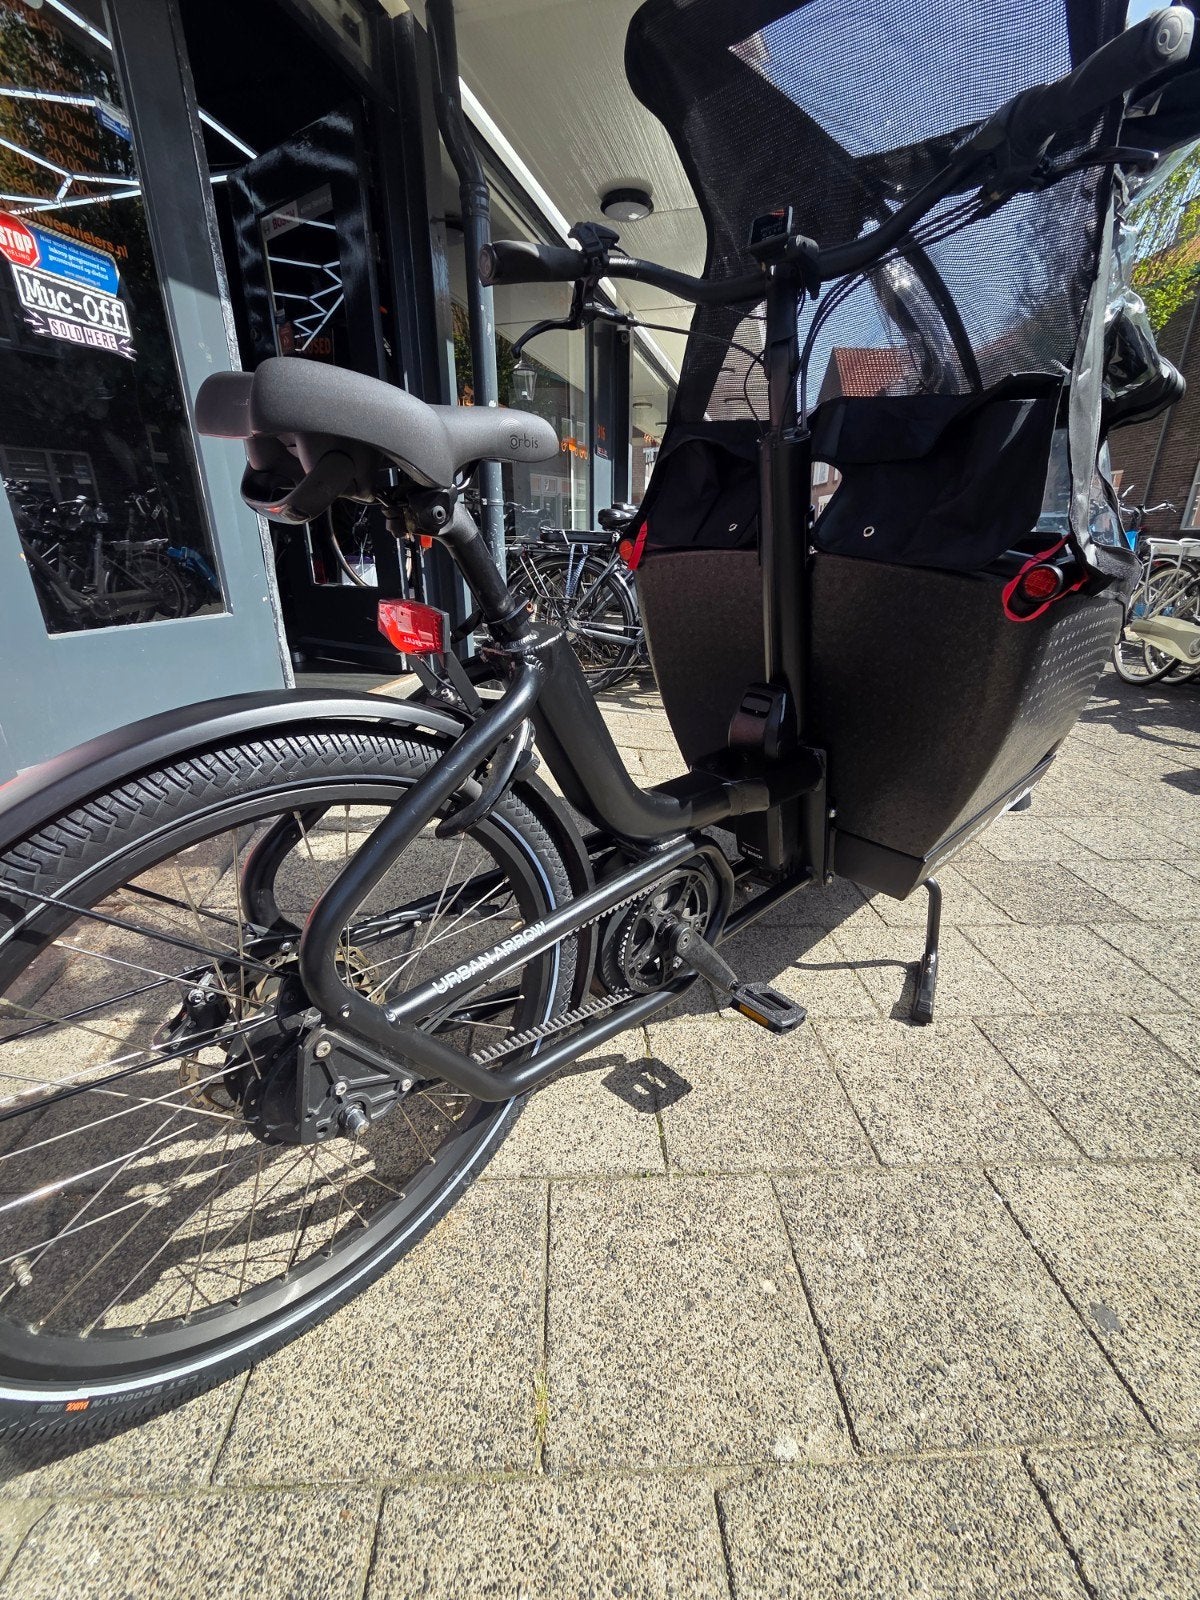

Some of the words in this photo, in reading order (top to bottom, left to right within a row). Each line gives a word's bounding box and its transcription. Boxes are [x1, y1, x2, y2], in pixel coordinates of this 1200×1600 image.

[20, 273, 124, 331] Muc-Off
[51, 320, 82, 342] SOLD
[84, 327, 117, 350] HERE
